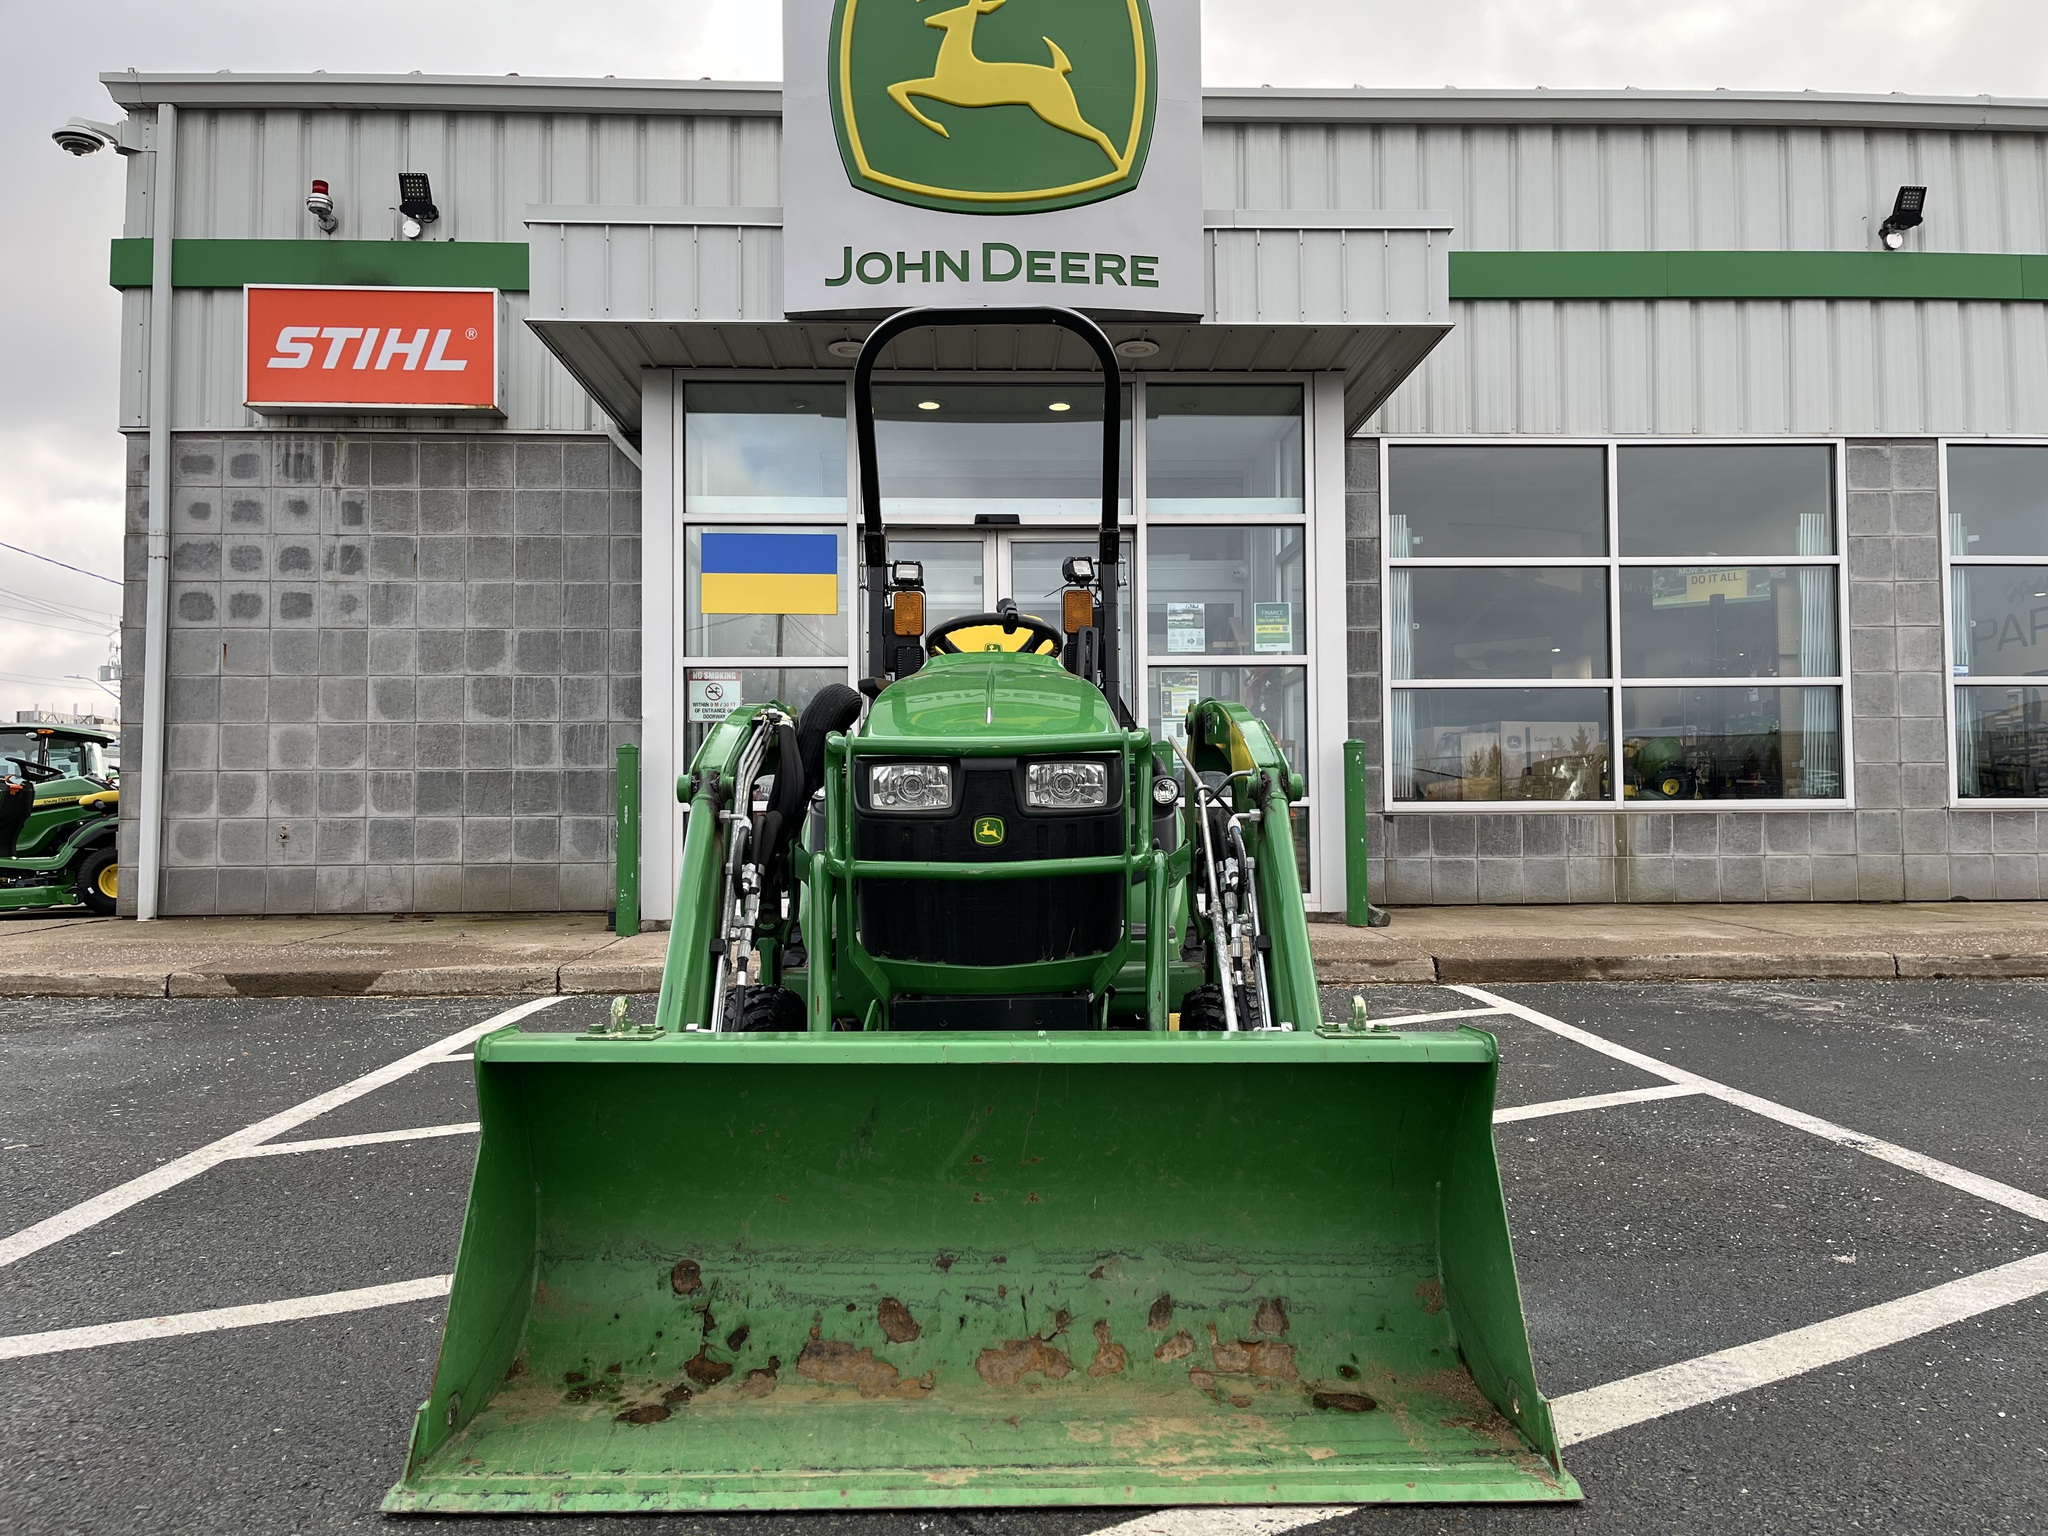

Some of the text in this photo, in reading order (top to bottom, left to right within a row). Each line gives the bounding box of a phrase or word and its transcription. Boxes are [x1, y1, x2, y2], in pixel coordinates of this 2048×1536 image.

[825, 243, 1160, 288] JOHN DEERE
[267, 326, 468, 371] STIHL
[1691, 575, 1706, 585] DO
[1708, 574, 1719, 584] IT
